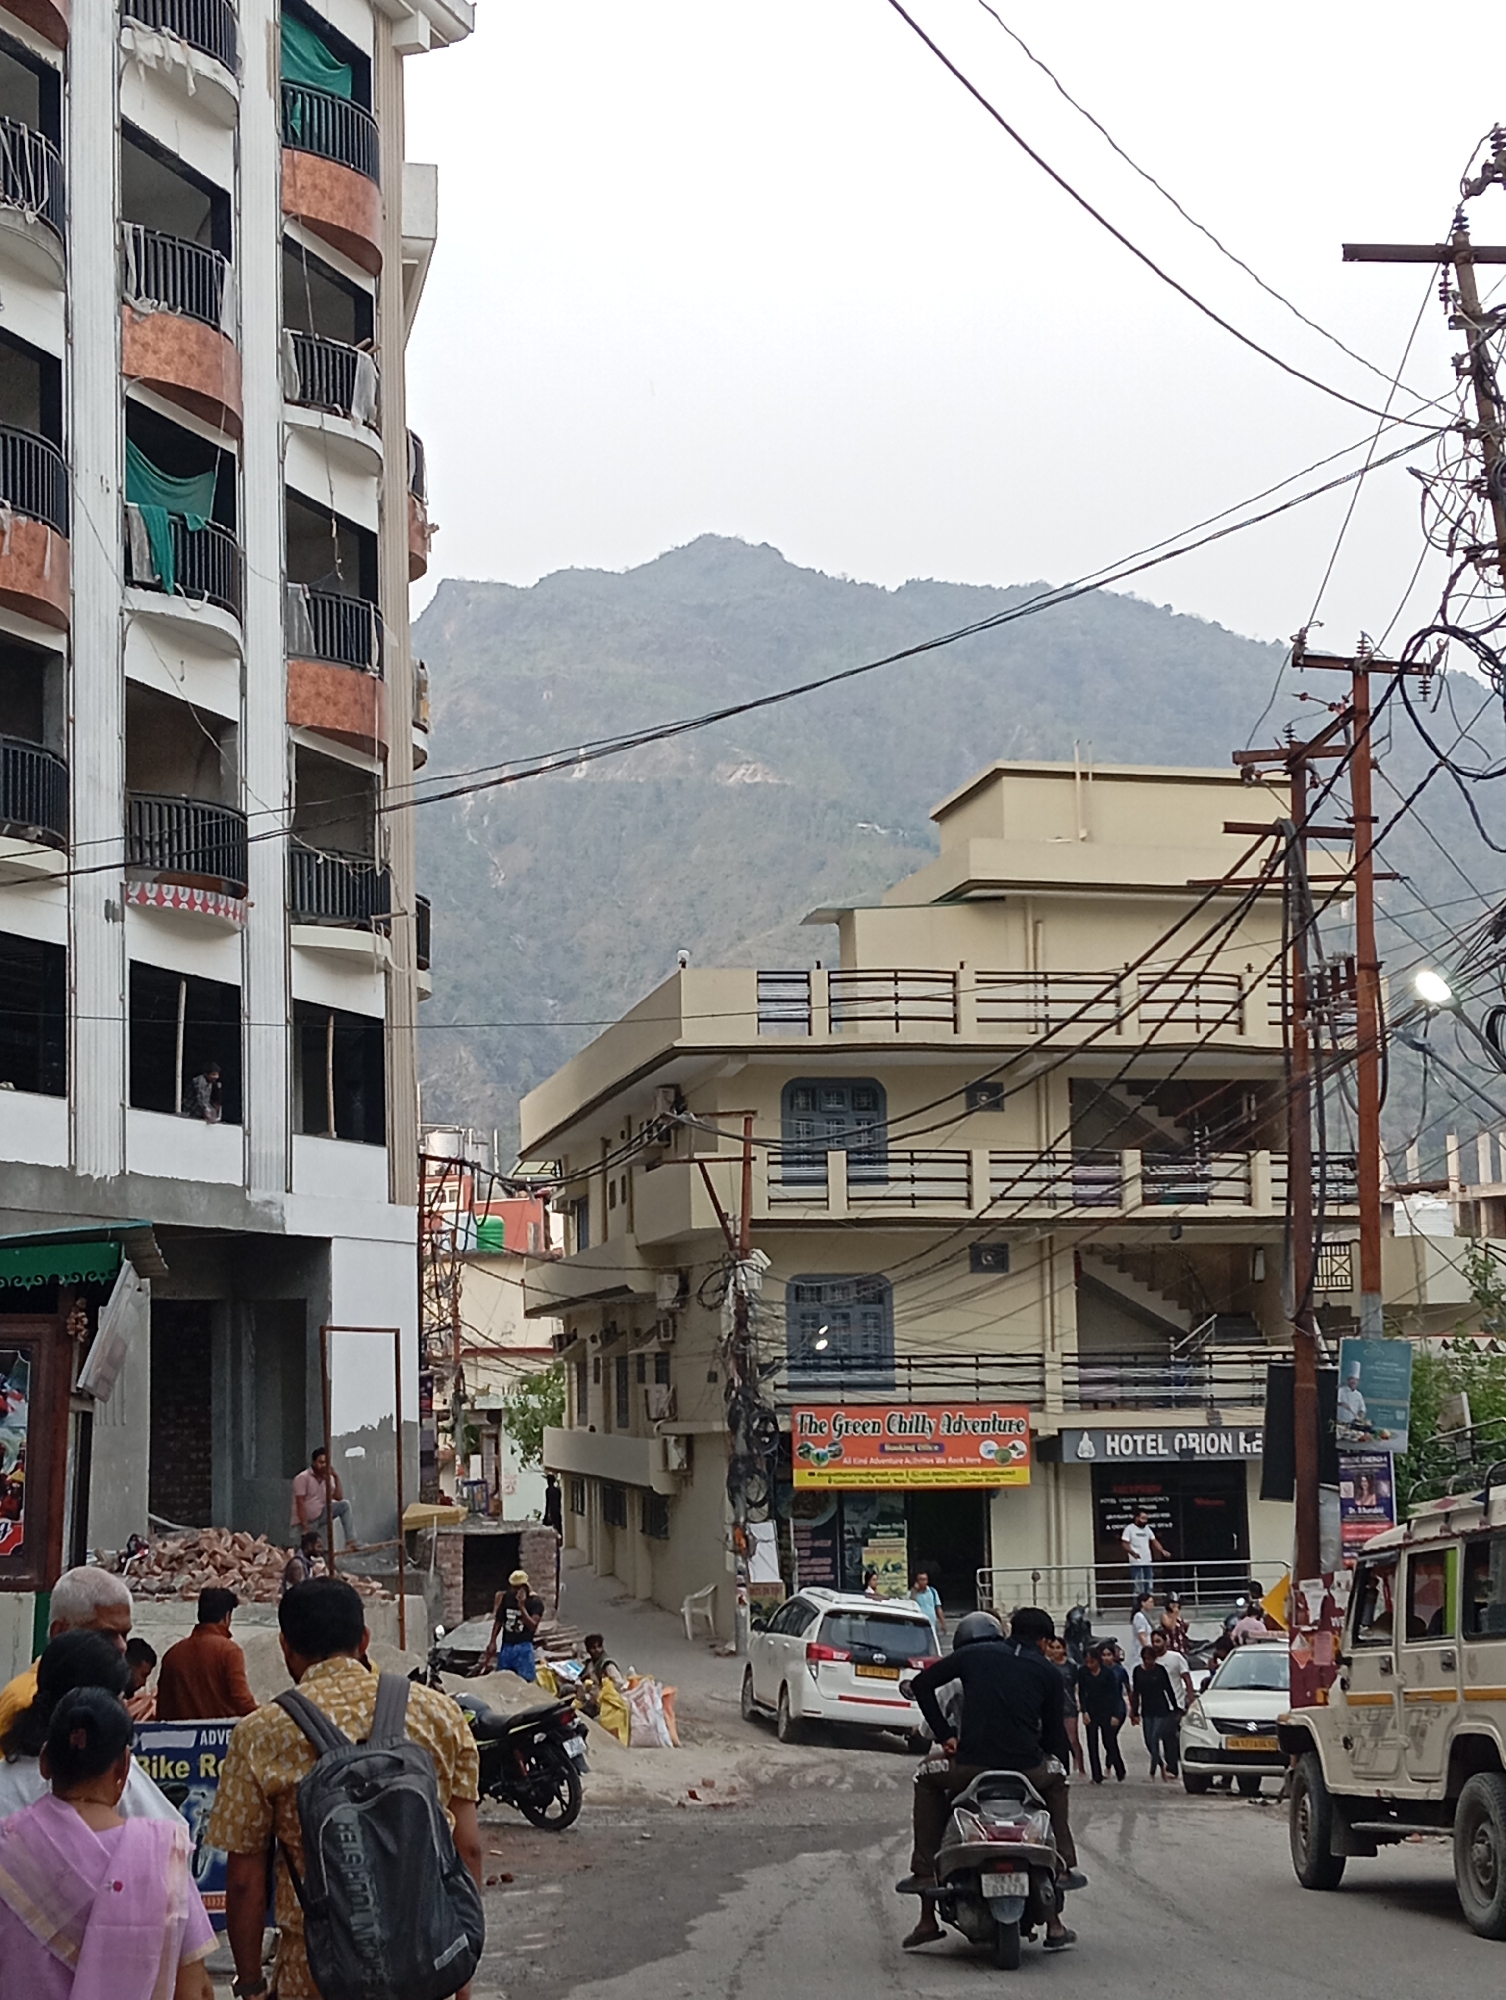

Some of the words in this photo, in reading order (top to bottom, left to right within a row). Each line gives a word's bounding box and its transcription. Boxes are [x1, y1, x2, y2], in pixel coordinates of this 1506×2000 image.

[797, 1412, 828, 1436] The
[831, 1412, 882, 1440] Green
[886, 1412, 936, 1440] Chilly
[940, 1412, 1026, 1436] Adventure
[1106, 1434, 1169, 1456] HOTEL
[137, 1754, 190, 1779] Bike
